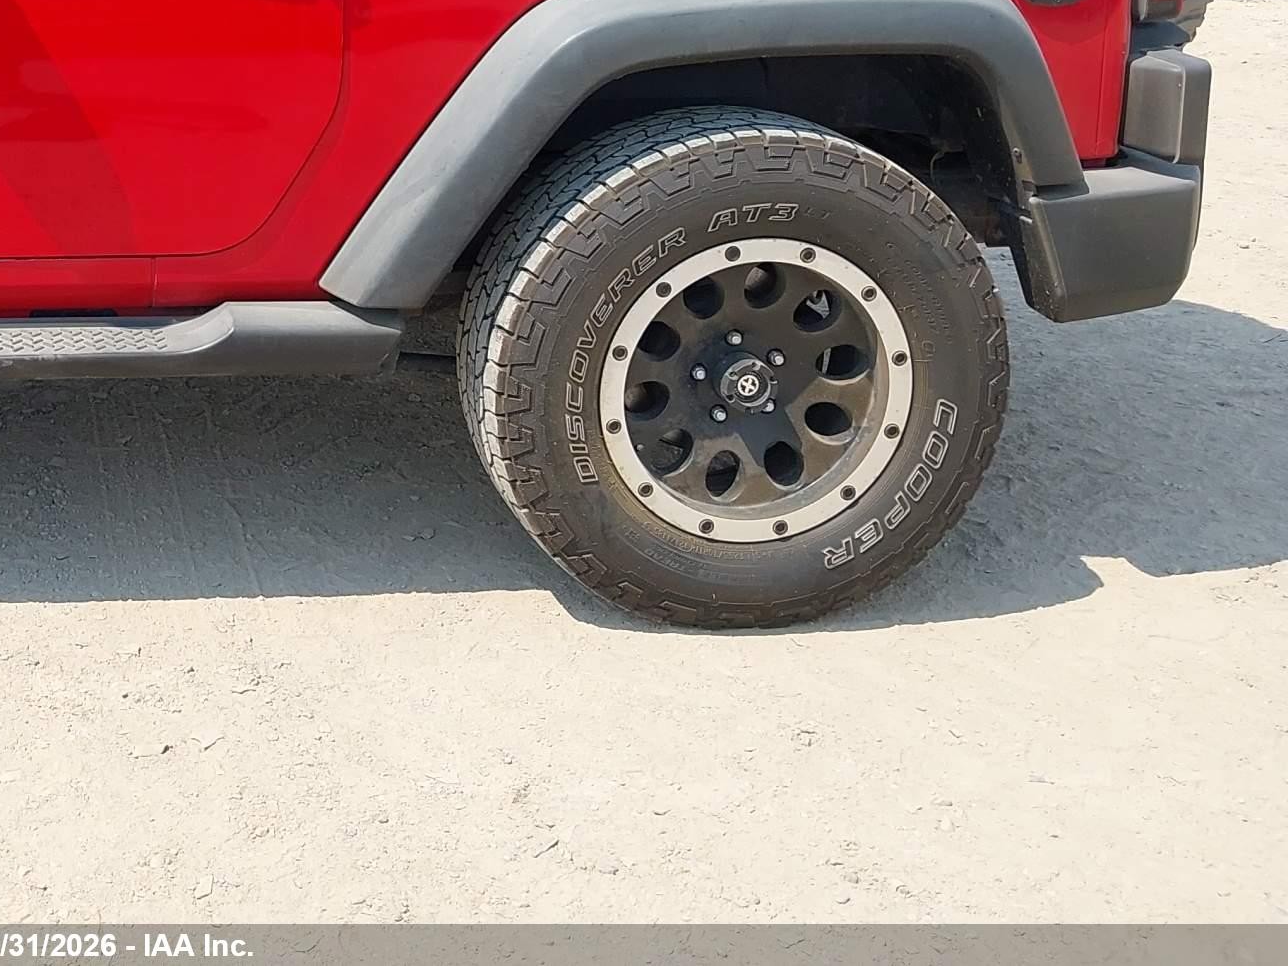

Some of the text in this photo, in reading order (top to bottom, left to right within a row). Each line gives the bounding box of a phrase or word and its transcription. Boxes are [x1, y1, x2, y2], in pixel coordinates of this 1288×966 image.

[564, 226, 687, 485] DISCOVERER
[707, 203, 799, 232] AT3
[823, 398, 959, 571] COOPER
